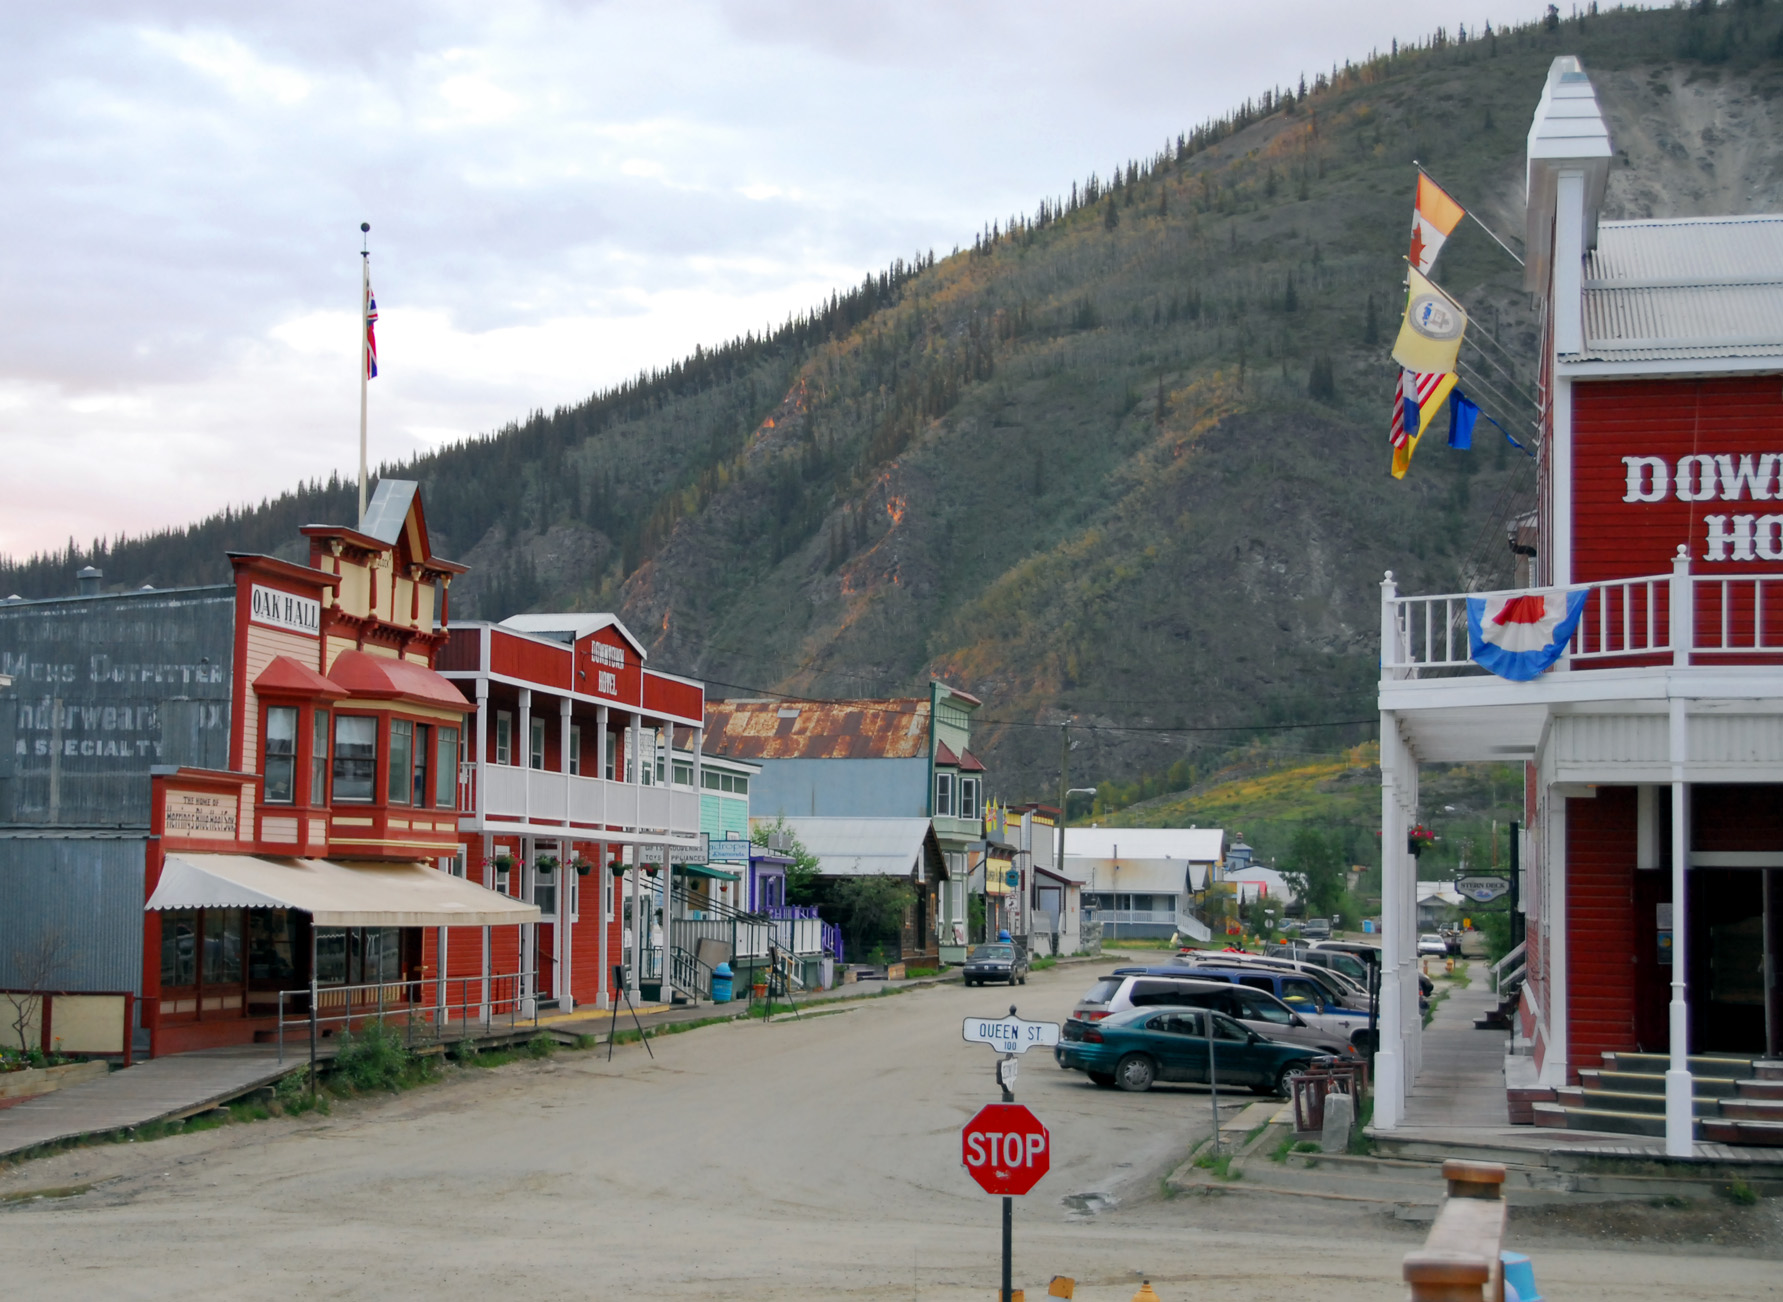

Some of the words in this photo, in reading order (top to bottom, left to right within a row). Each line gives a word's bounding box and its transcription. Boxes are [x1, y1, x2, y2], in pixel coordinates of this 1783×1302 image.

[1621, 454, 1783, 502] DOW
[1702, 514, 1783, 561] HO
[253, 589, 280, 619] OAK
[285, 597, 318, 629] HALL
[591, 640, 625, 669] DOWNTOWN
[598, 670, 617, 696] HOTEL
[980, 1023, 1019, 1039] QUEEN
[1028, 1026, 1043, 1041] ST.
[1004, 1042, 1017, 1050] 100
[966, 1131, 1045, 1168] STOP
